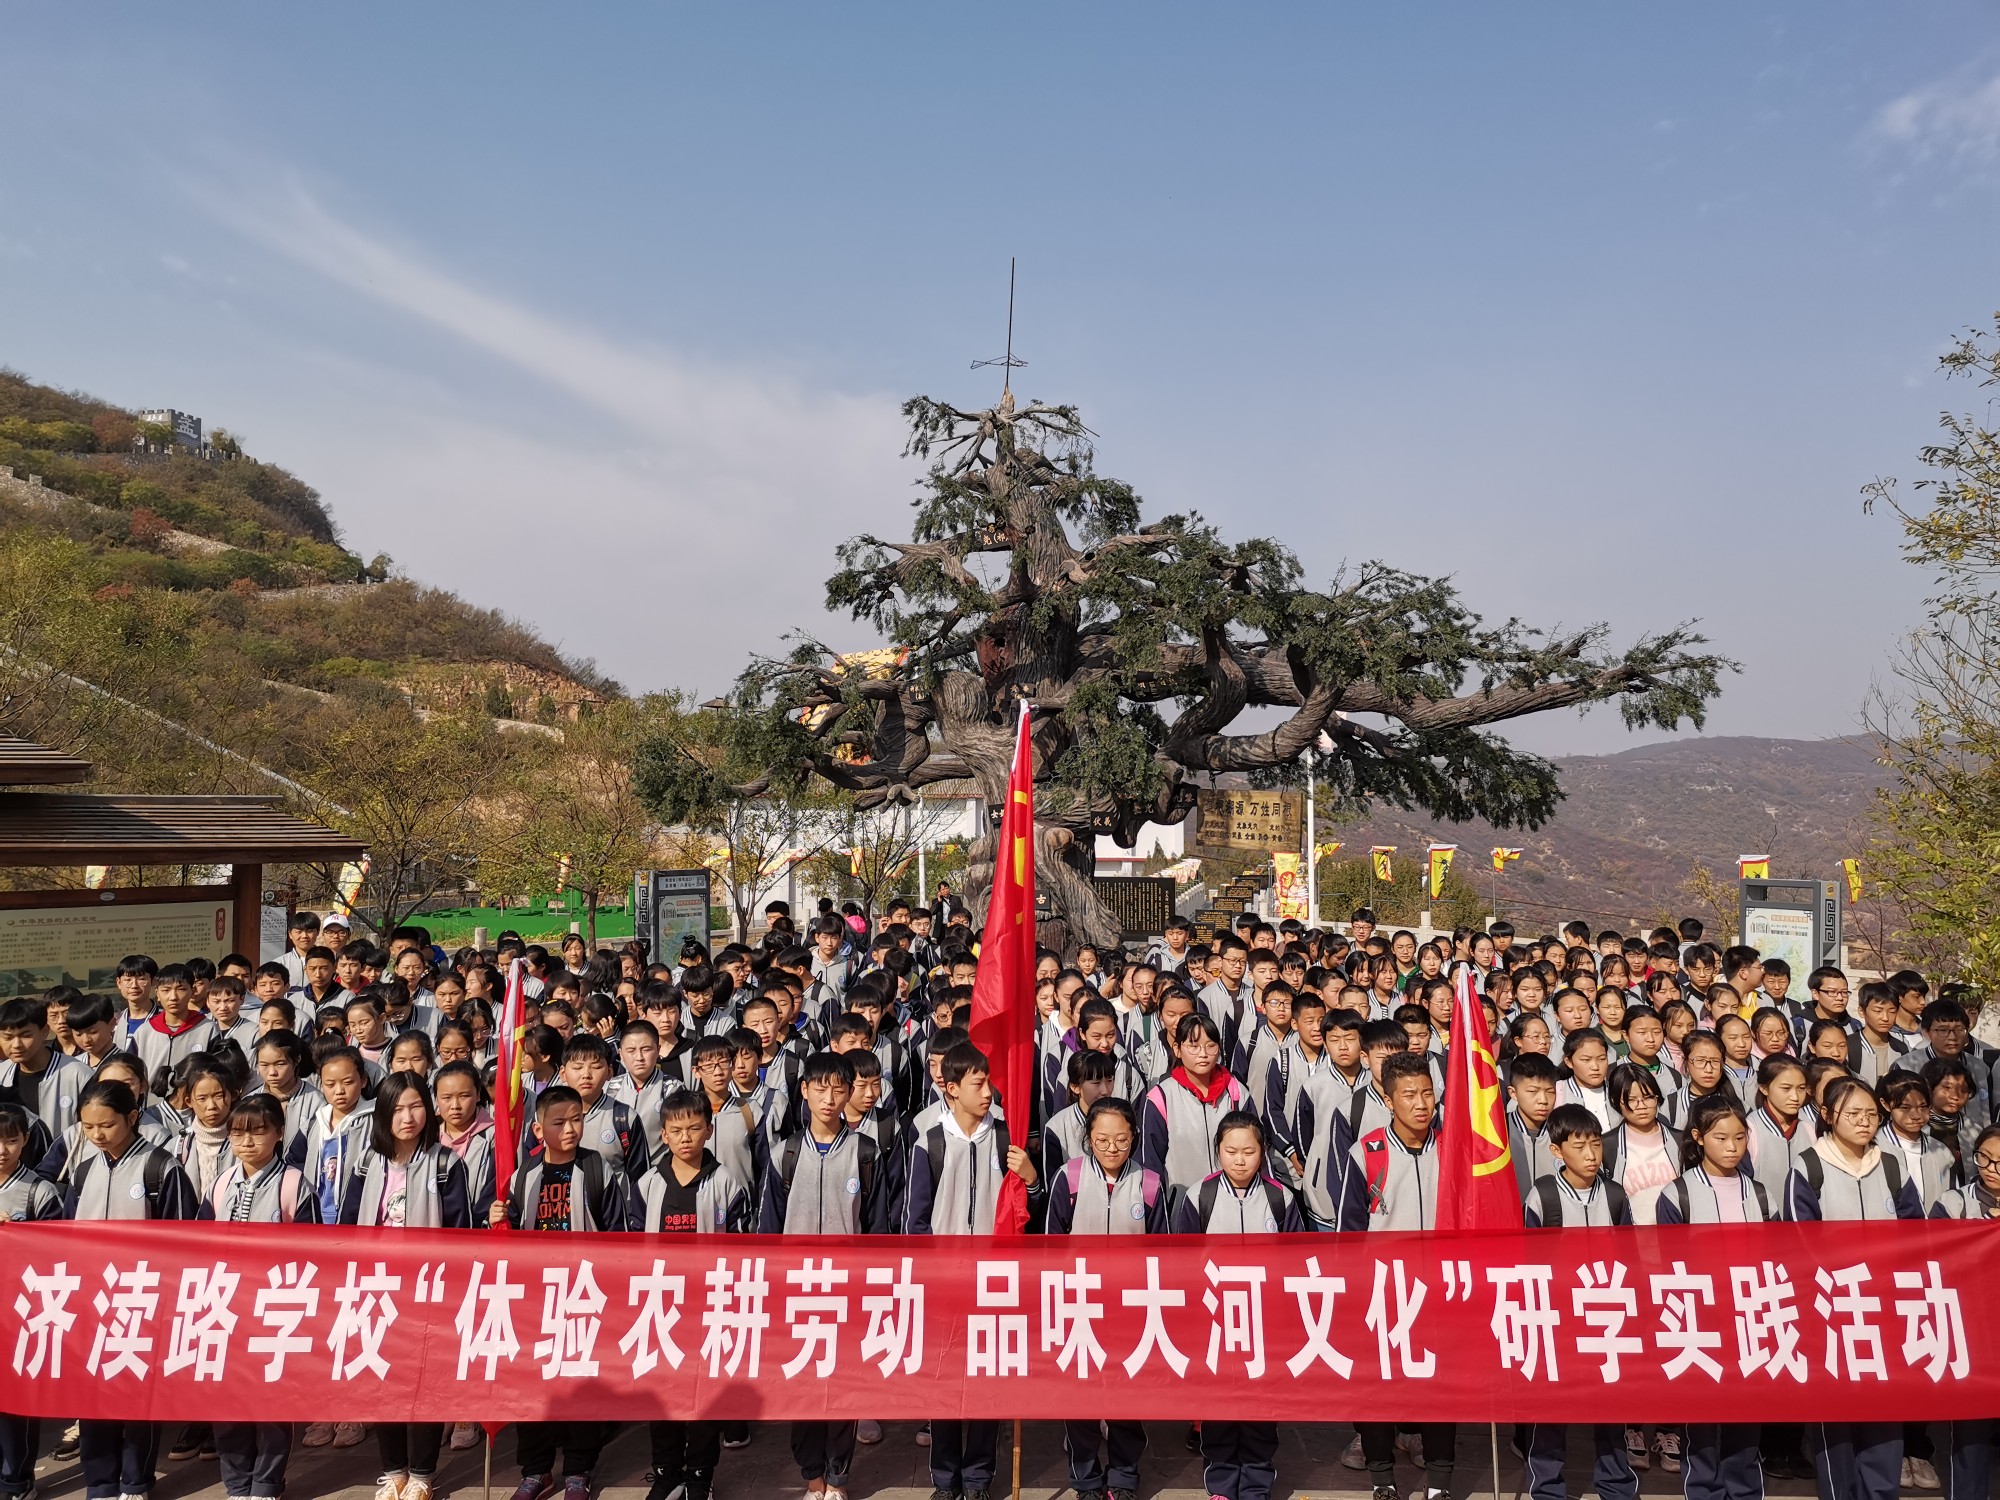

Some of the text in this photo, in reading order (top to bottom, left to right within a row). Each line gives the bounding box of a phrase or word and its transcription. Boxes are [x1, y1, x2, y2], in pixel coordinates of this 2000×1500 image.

[12, 1255, 1970, 1383] 济渎路学校“体验农耕劳动 品味大河文化”研学实践活动
